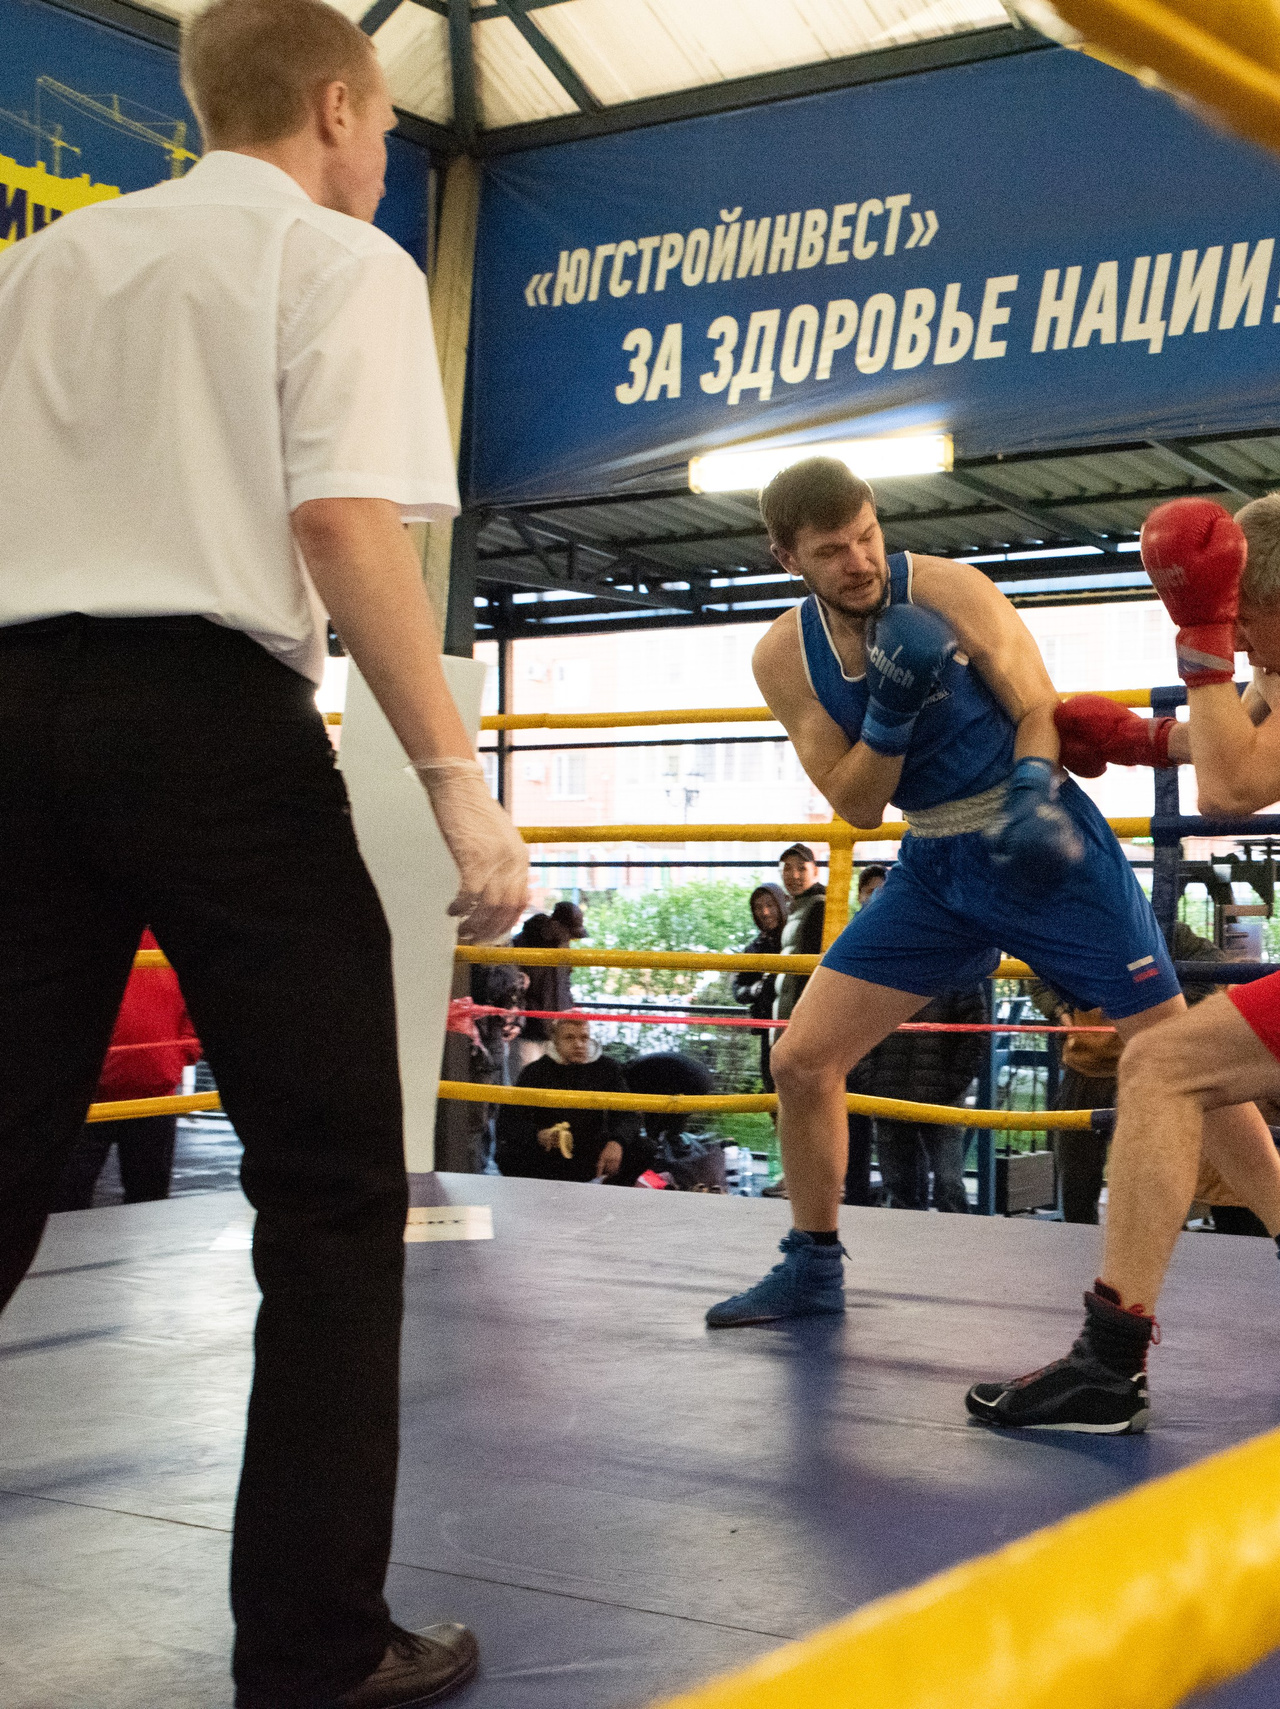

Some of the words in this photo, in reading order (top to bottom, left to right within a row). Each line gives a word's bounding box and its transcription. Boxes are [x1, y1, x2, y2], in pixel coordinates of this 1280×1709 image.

[524, 193, 940, 308] «ЮГСТРОЙИНВЕСТ»
[615, 322, 683, 405] ЗА
[699, 274, 1019, 405] ЗДОРОВЬЕ
[869, 645, 916, 689] clinch
